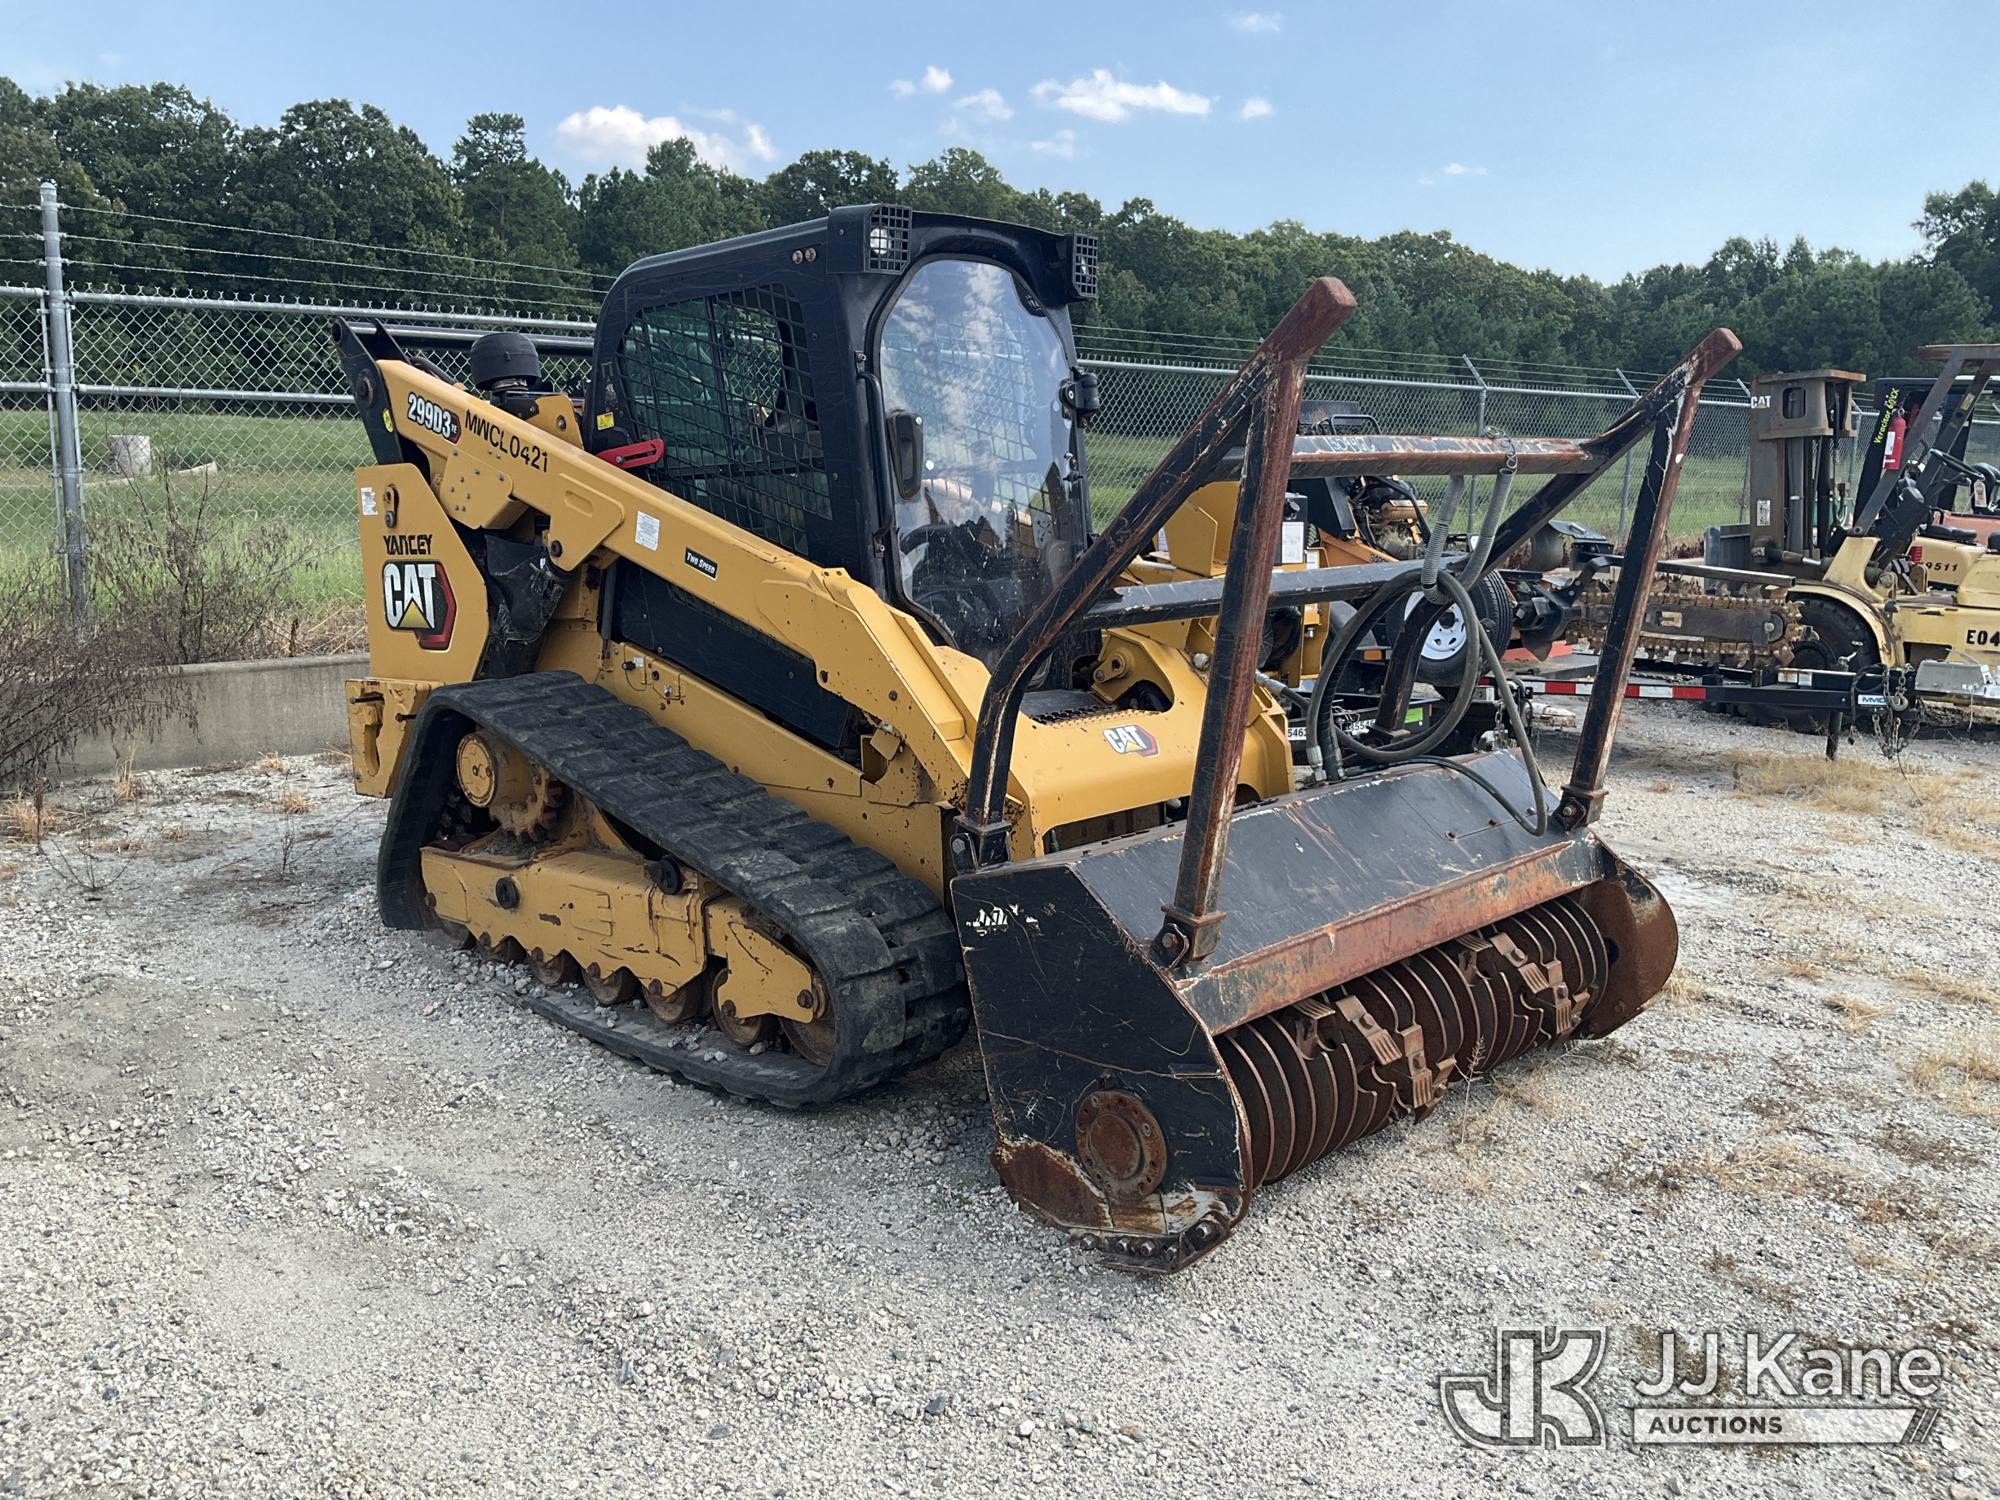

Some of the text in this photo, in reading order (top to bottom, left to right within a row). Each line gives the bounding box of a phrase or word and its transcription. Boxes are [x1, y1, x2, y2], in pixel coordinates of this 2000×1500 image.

[1751, 395, 1771, 409] CAT
[407, 392, 451, 438] 299D3
[383, 534, 433, 556] YANCEY
[384, 563, 437, 630] CAT
[1966, 629, 2000, 647] E04
[1103, 726, 1148, 754] CAT
